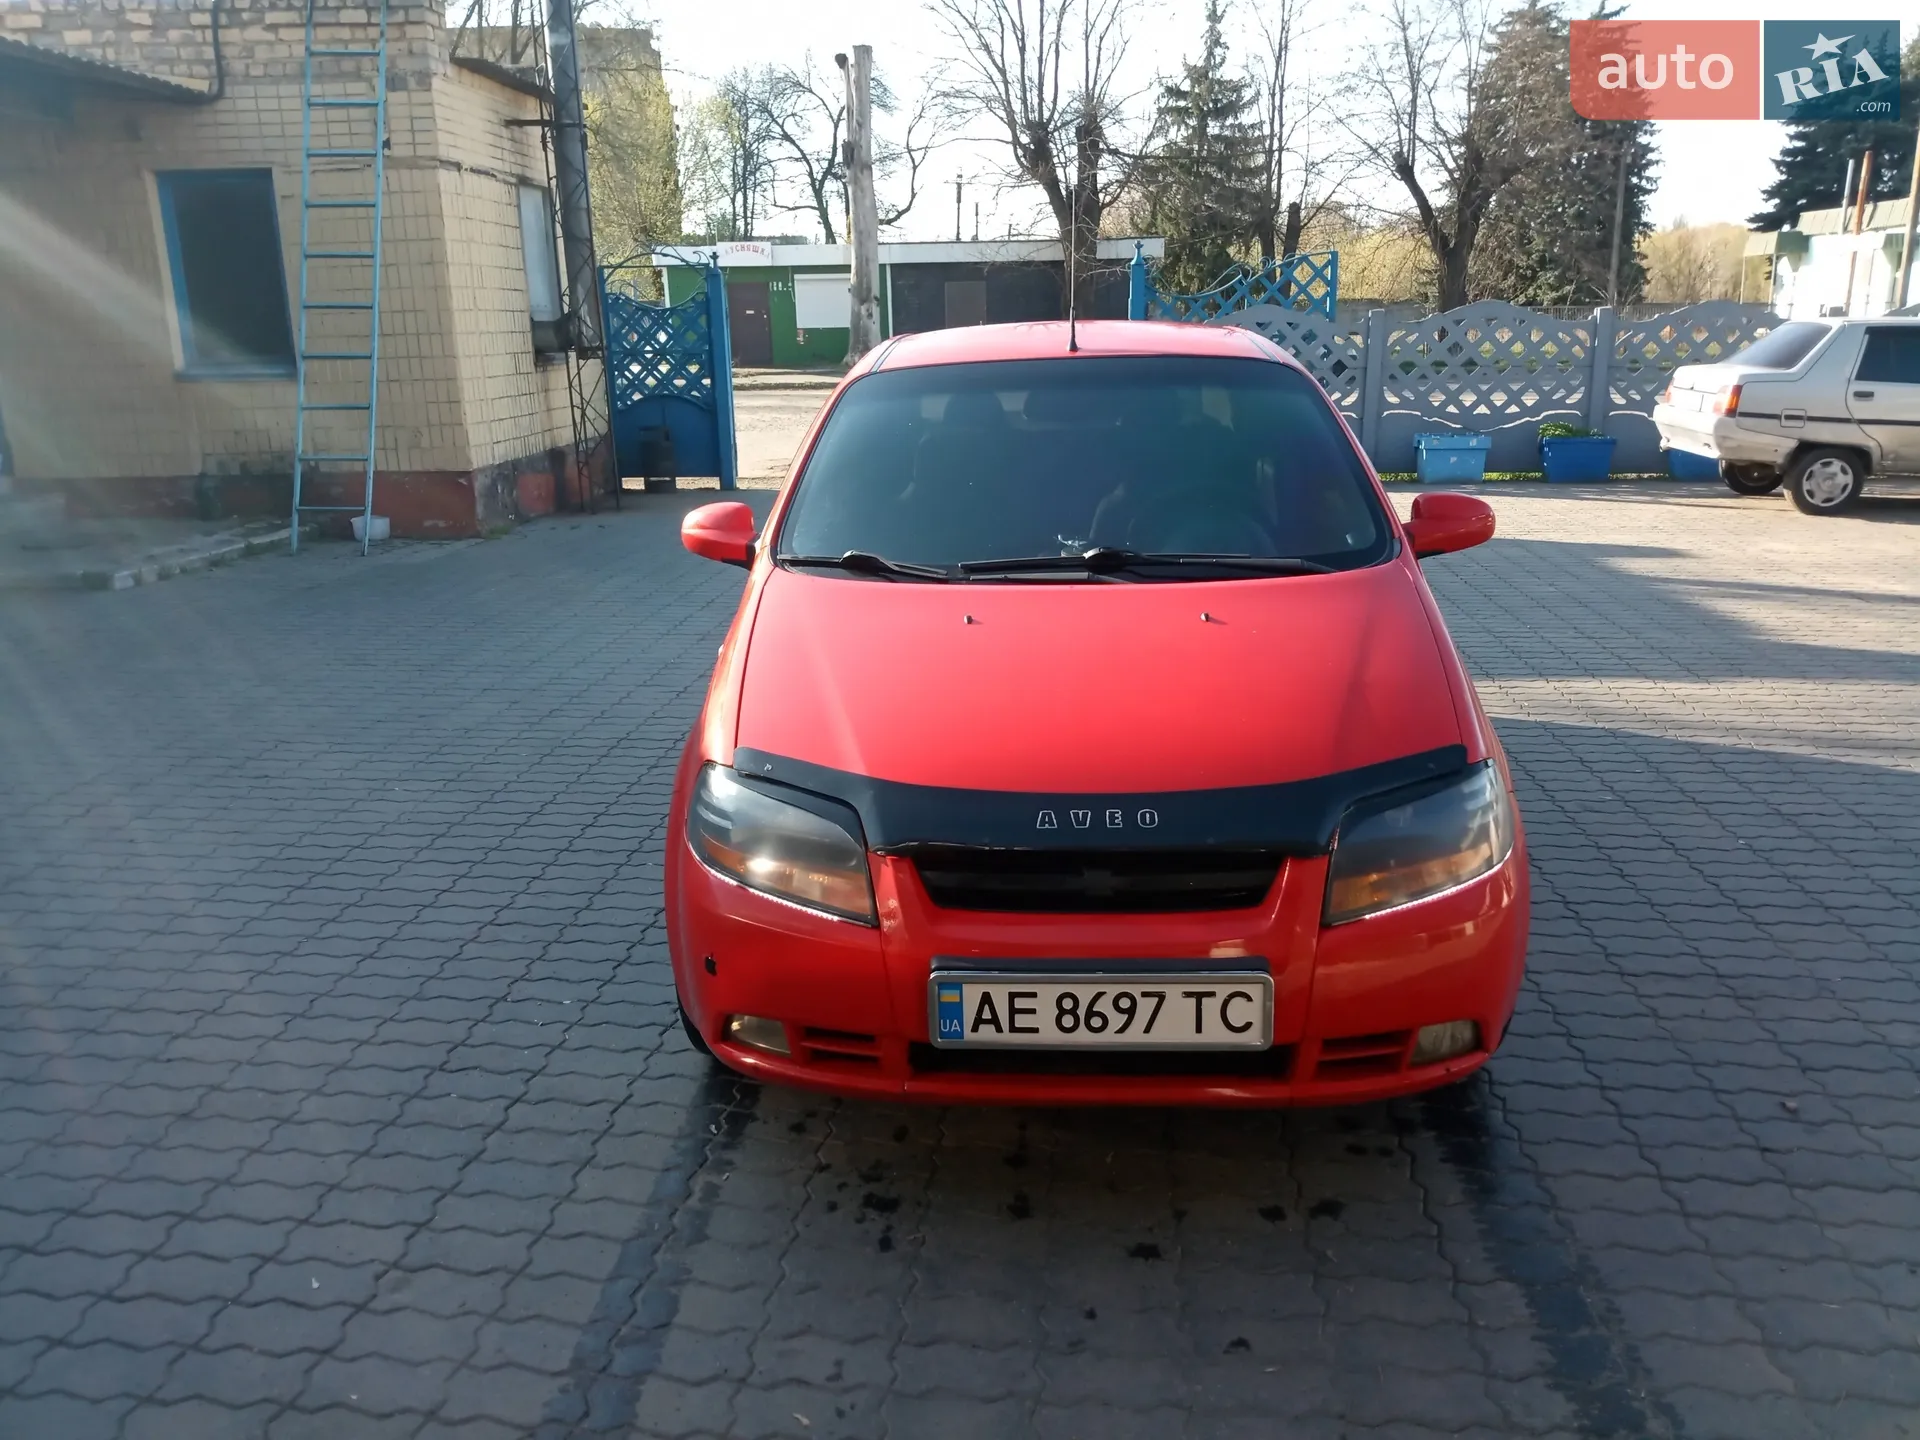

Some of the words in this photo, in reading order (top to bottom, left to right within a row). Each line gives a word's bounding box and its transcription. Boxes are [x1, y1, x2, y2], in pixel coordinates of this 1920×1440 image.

[1036, 808, 1159, 829] AVEO
[970, 991, 1040, 1034] AE
[1055, 991, 1167, 1034] 8697
[1182, 990, 1254, 1034] TC
[940, 1019, 961, 1032] UA
